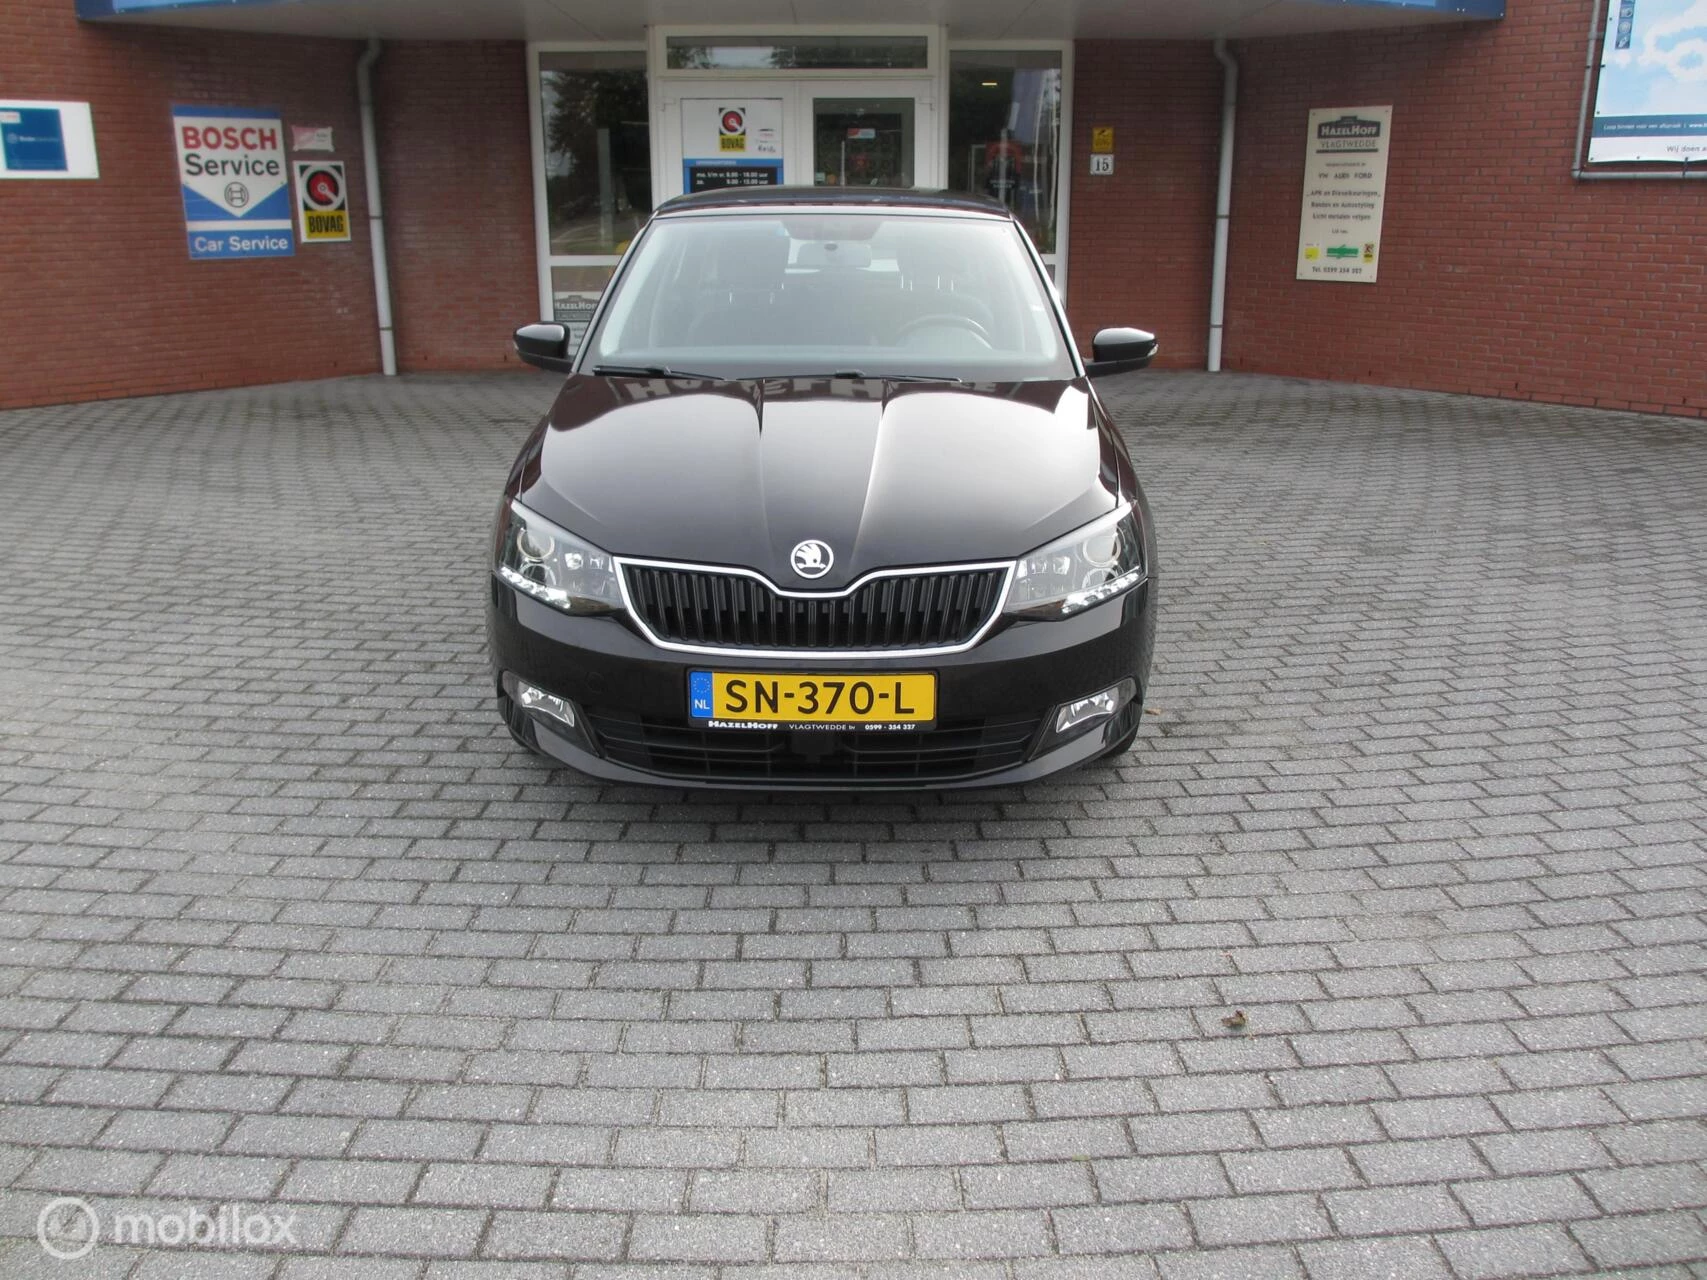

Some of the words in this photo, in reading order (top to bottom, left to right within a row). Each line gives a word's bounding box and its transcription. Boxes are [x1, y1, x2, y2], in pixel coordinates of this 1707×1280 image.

[181, 126, 278, 150] BOSCH
[720, 138, 744, 149] BOVAG
[1321, 140, 1376, 148] VLAGTWEDDE
[185, 153, 280, 176] Service
[1095, 157, 1109, 171] 15
[308, 215, 344, 233] BOVAG
[194, 236, 224, 252] Car
[228, 236, 288, 251] Service
[694, 699, 710, 710] NL
[725, 680, 915, 715] SN-370-L
[789, 723, 846, 731] VLAGTWEDDE
[864, 723, 883, 731] 0599
